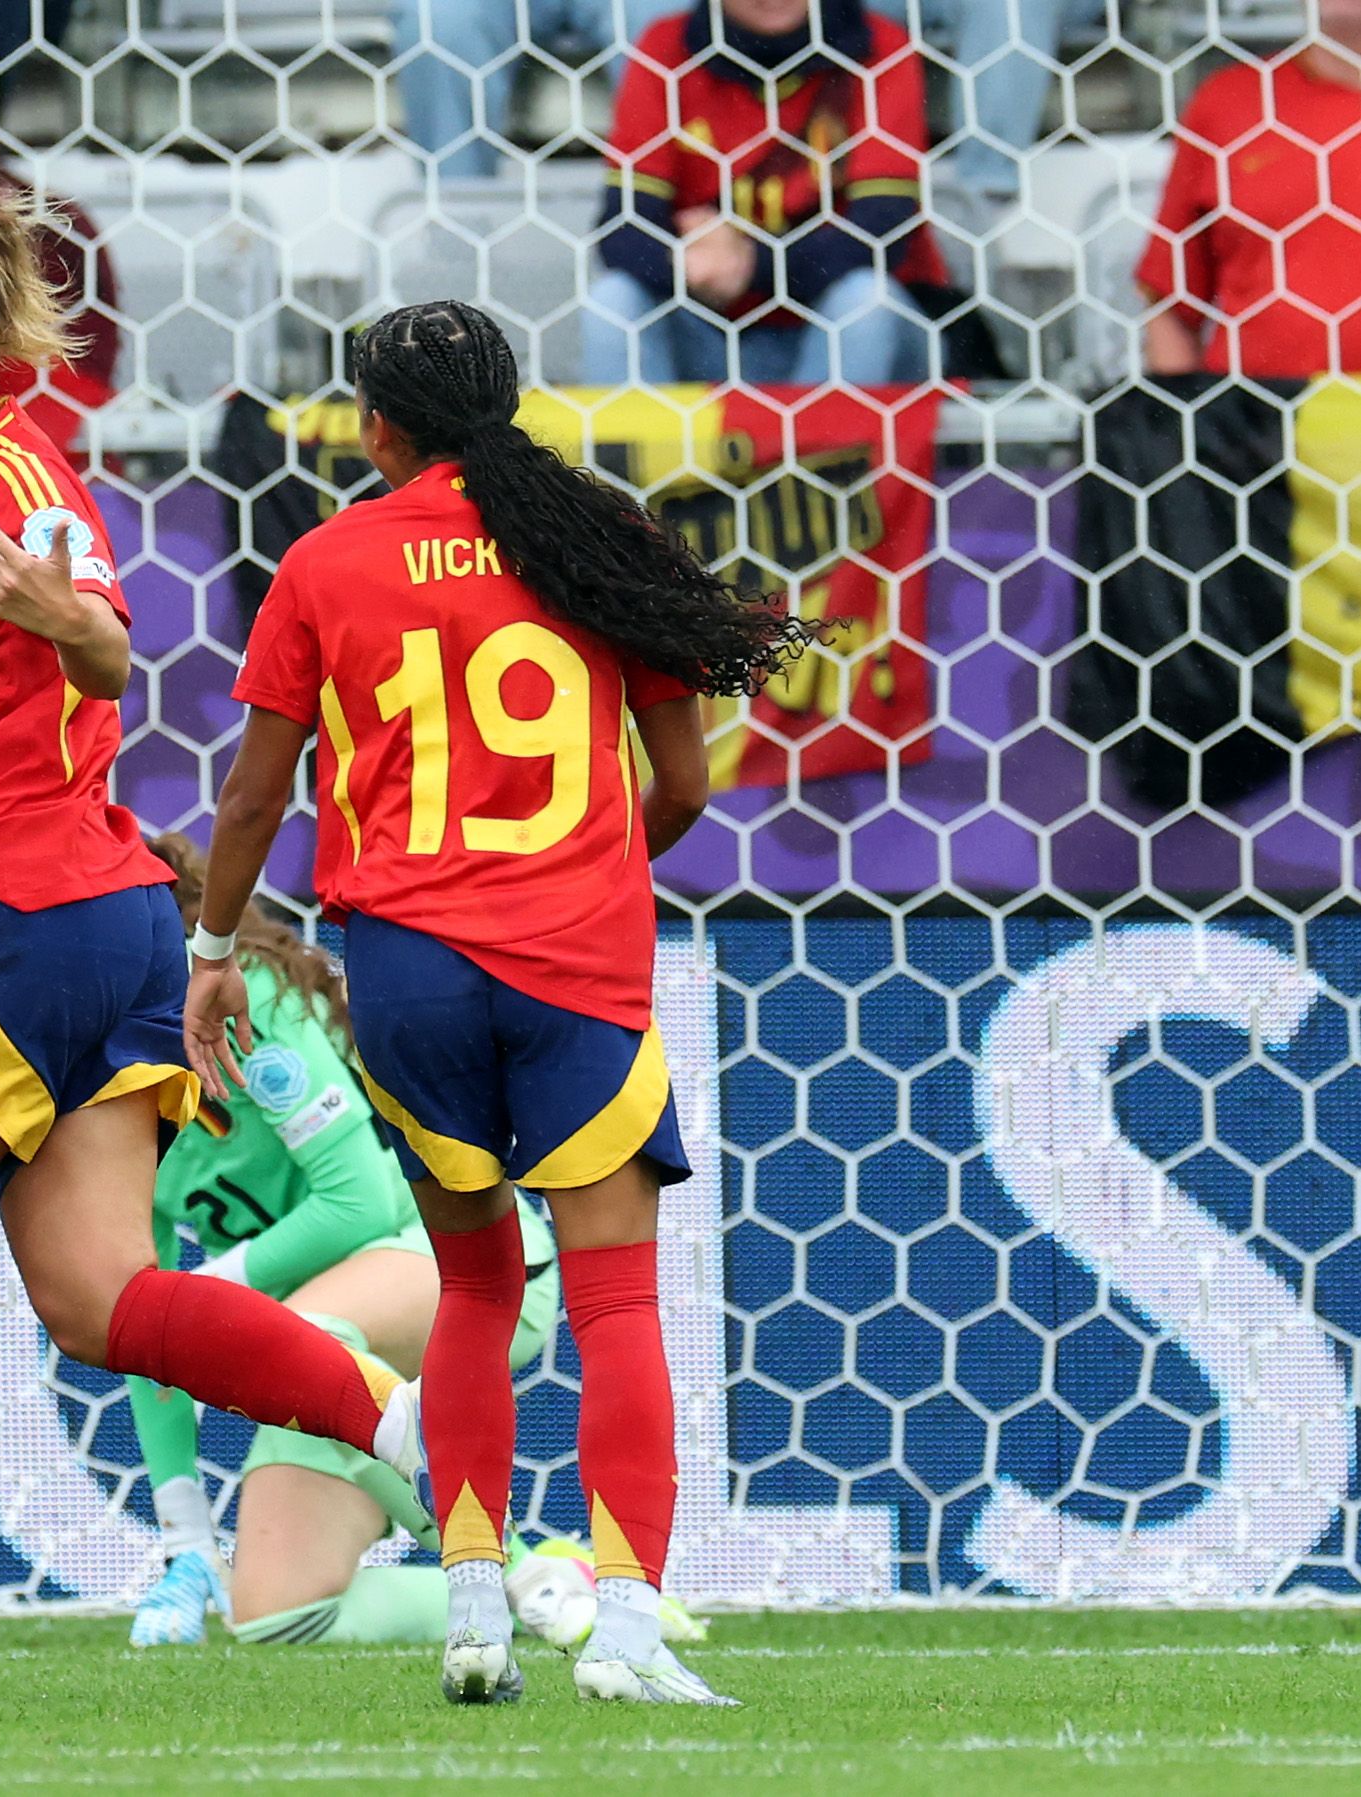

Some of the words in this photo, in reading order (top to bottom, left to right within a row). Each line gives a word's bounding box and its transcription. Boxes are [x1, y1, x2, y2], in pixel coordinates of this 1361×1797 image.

[402, 537, 524, 585] VICK
[374, 621, 591, 856] 19
[184, 1174, 278, 1242] 21
